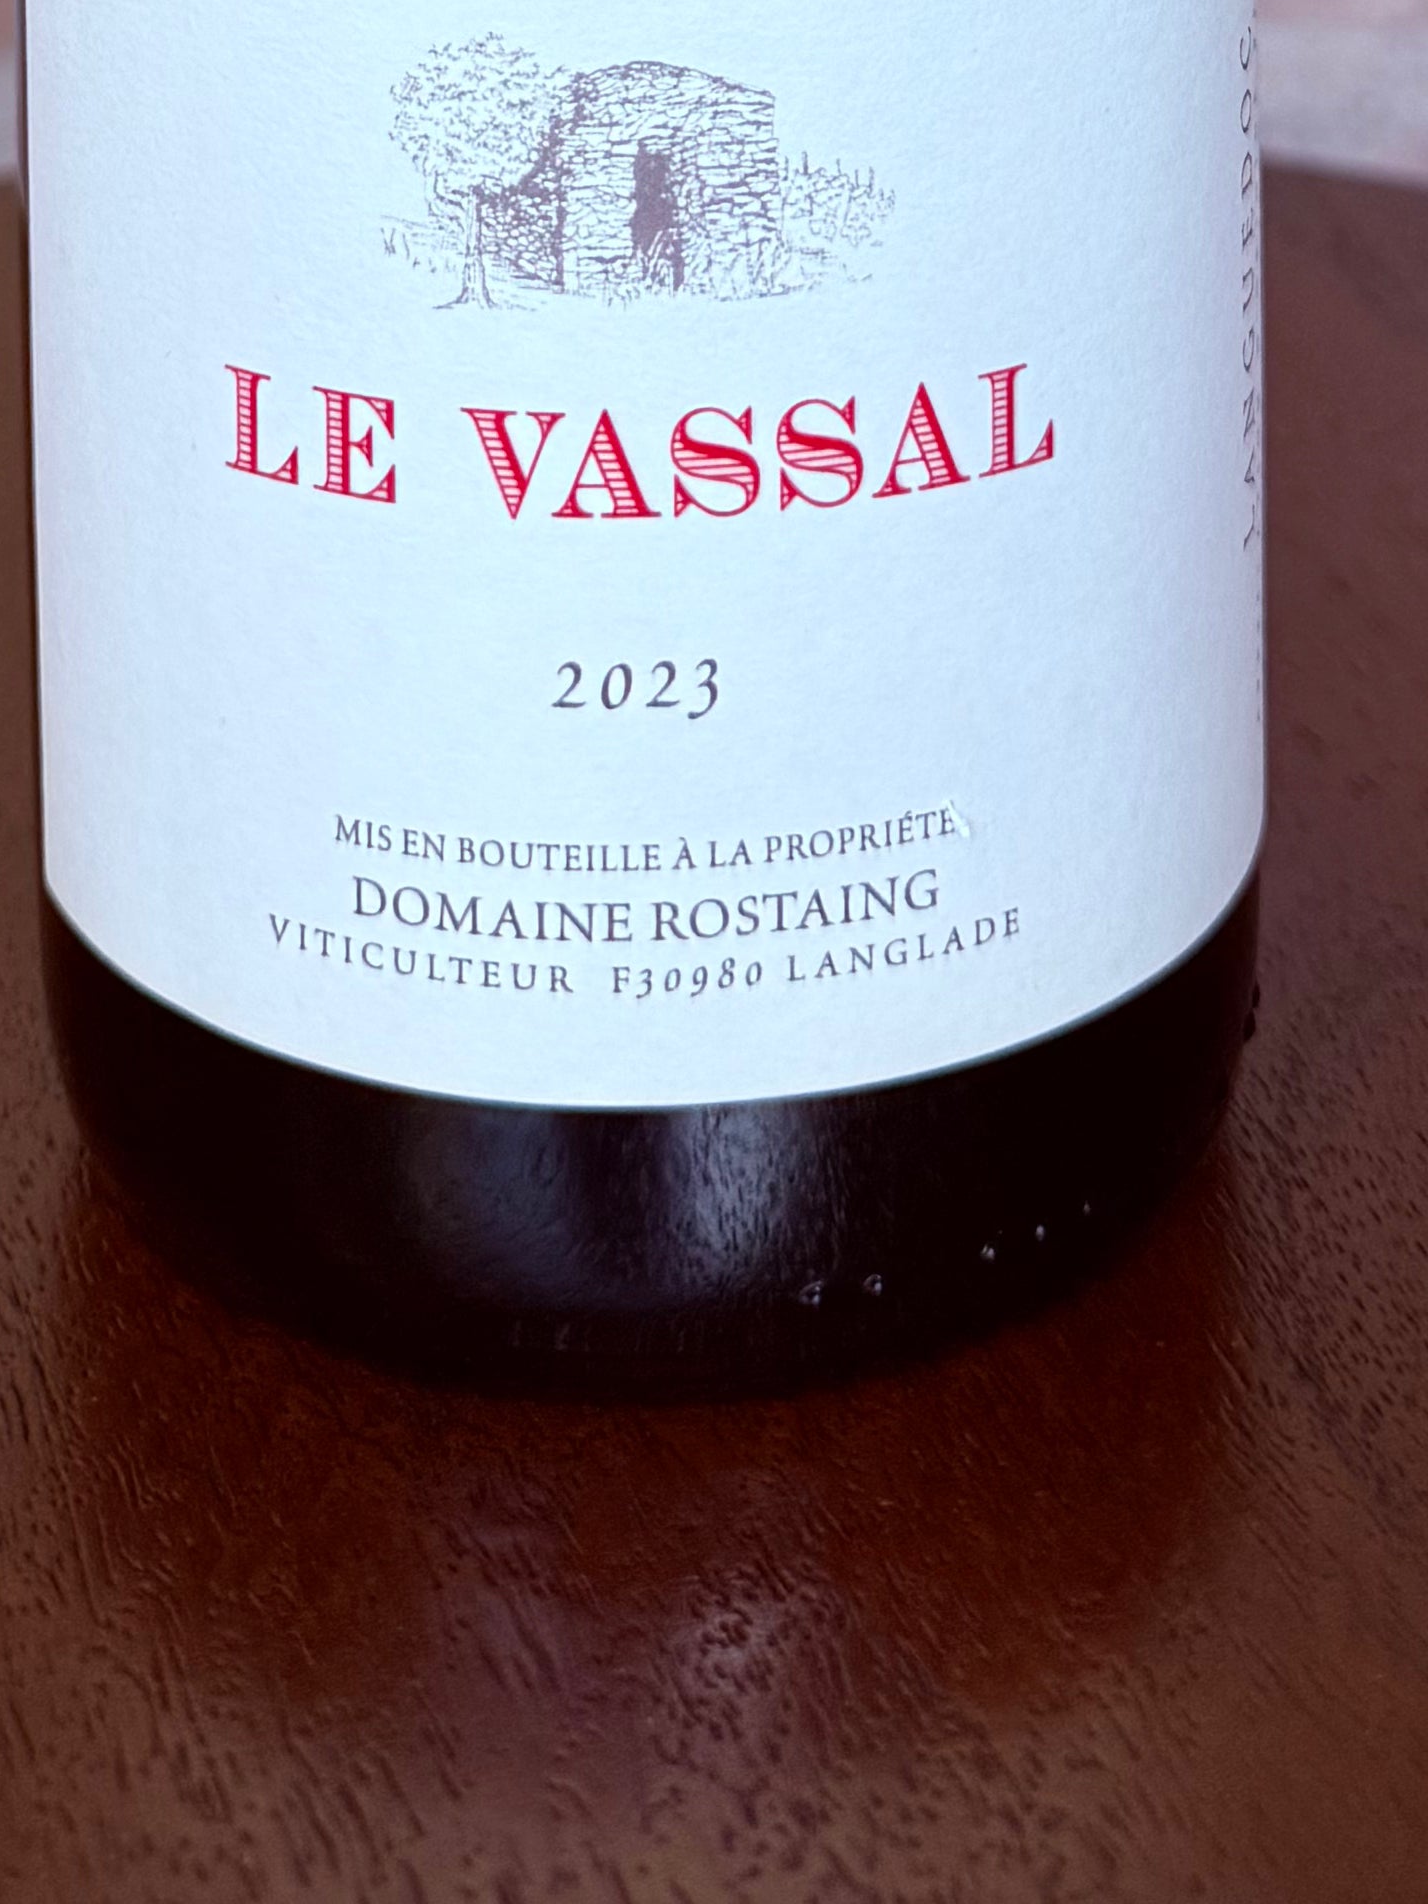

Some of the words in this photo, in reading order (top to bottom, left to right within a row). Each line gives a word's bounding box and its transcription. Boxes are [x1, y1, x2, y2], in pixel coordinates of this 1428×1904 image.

[1239, 25, 1256, 551] LANGUEDOC
[224, 363, 397, 505] LE
[459, 363, 1055, 521] VASSAL
[551, 658, 719, 721] 2023
[334, 814, 392, 852] MIS
[401, 828, 446, 863] EN
[456, 836, 662, 873] BOUTEILLE
[671, 836, 698, 871] À
[708, 839, 753, 869] LA
[352, 875, 633, 943] DOMAINE
[650, 868, 939, 942] ROSTAING
[269, 913, 574, 994] VITICULTEUR
[611, 956, 763, 1000] F30980
[787, 906, 1020, 983] LANGLADE
